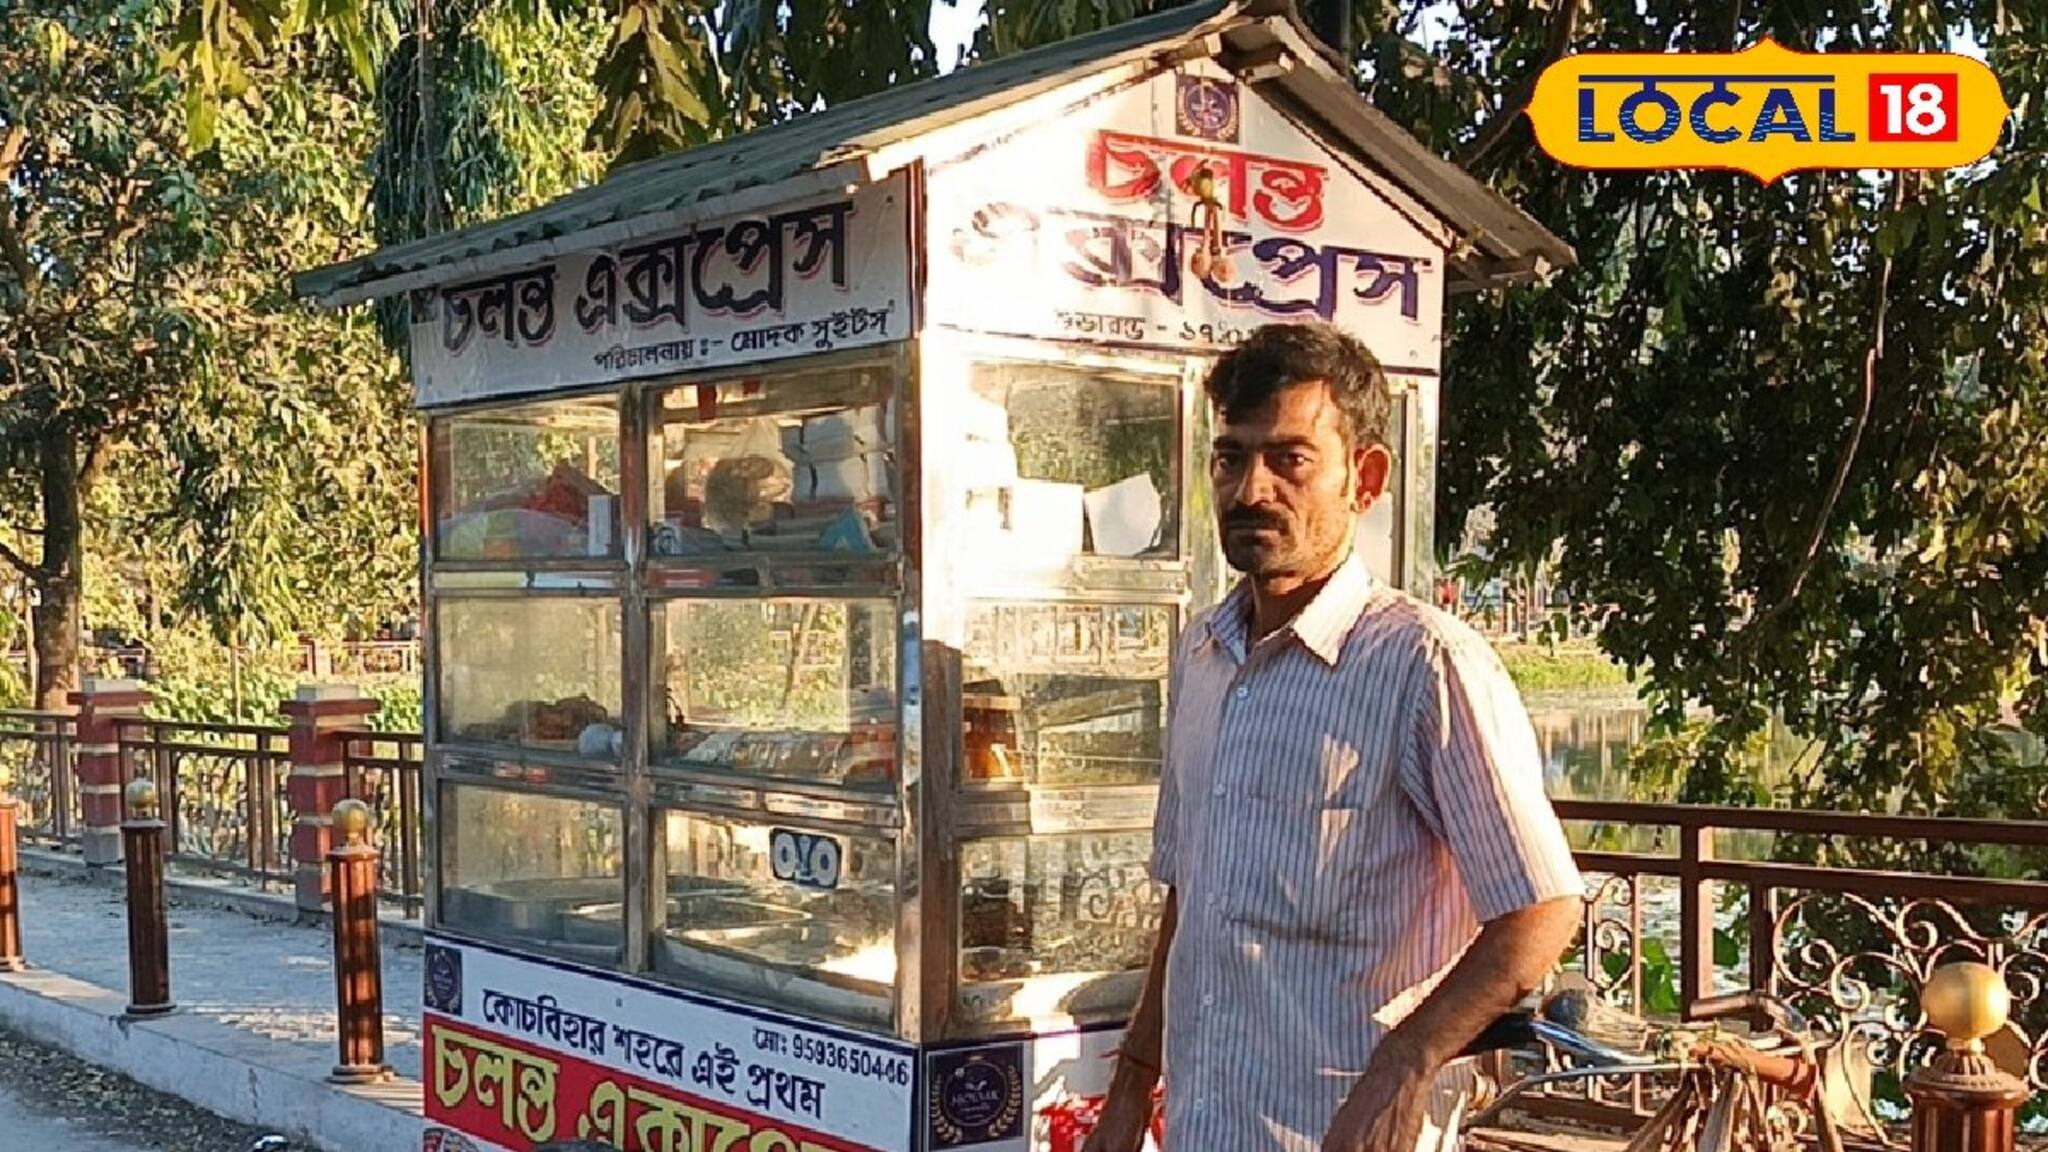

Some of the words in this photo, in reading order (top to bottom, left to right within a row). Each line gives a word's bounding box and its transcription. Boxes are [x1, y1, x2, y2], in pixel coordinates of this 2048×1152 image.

[1087, 129, 1327, 231] চলন্ত
[441, 264, 559, 354] চলন্ত
[573, 200, 857, 333] এক্সপ্রেস
[731, 321, 807, 352] মোদক
[431, 1023, 560, 1142] চলন্ত
[482, 989, 606, 1055] কোচবিহার
[613, 1025, 684, 1077] শহরে
[692, 1042, 740, 1094] এই
[746, 1062, 825, 1119] প্রথম
